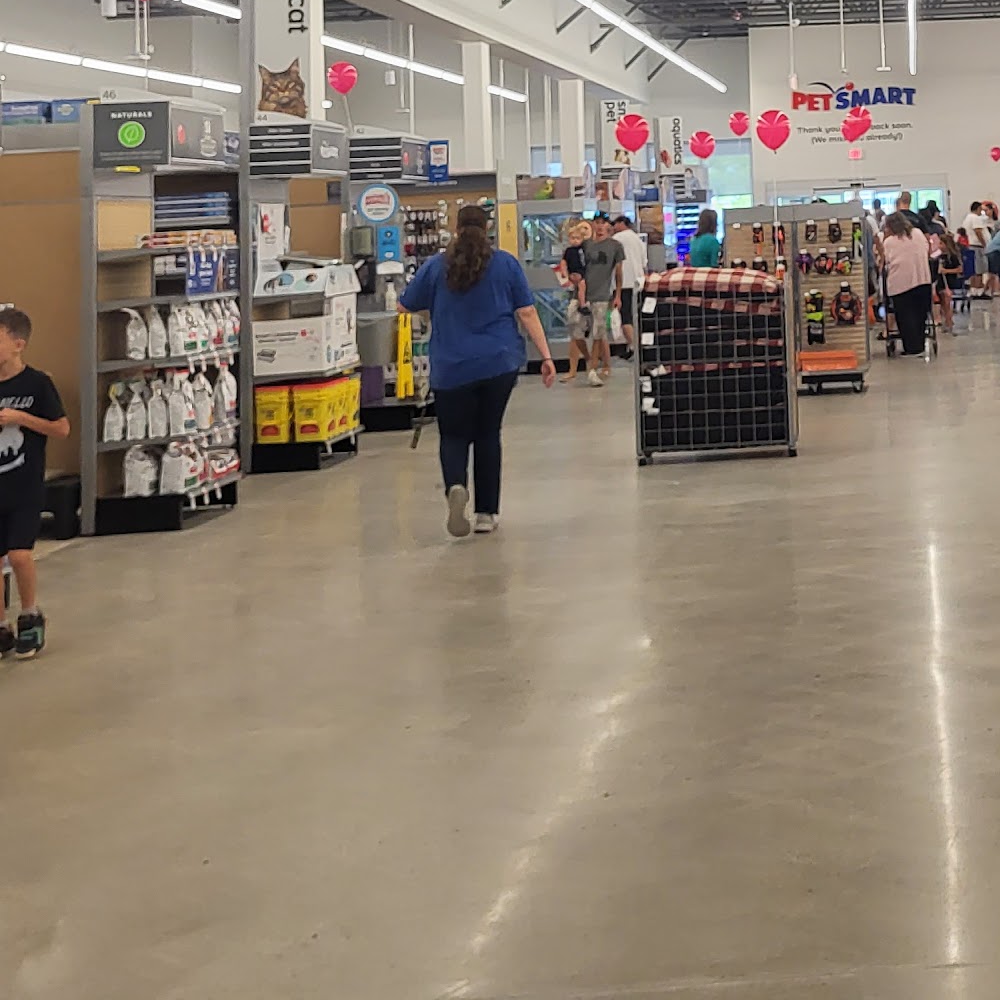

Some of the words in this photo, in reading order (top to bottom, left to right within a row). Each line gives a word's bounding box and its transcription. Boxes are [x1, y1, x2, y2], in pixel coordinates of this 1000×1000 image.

[102, 89, 117, 100] 46
[604, 101, 616, 123] pet
[671, 117, 683, 165] aquatics
